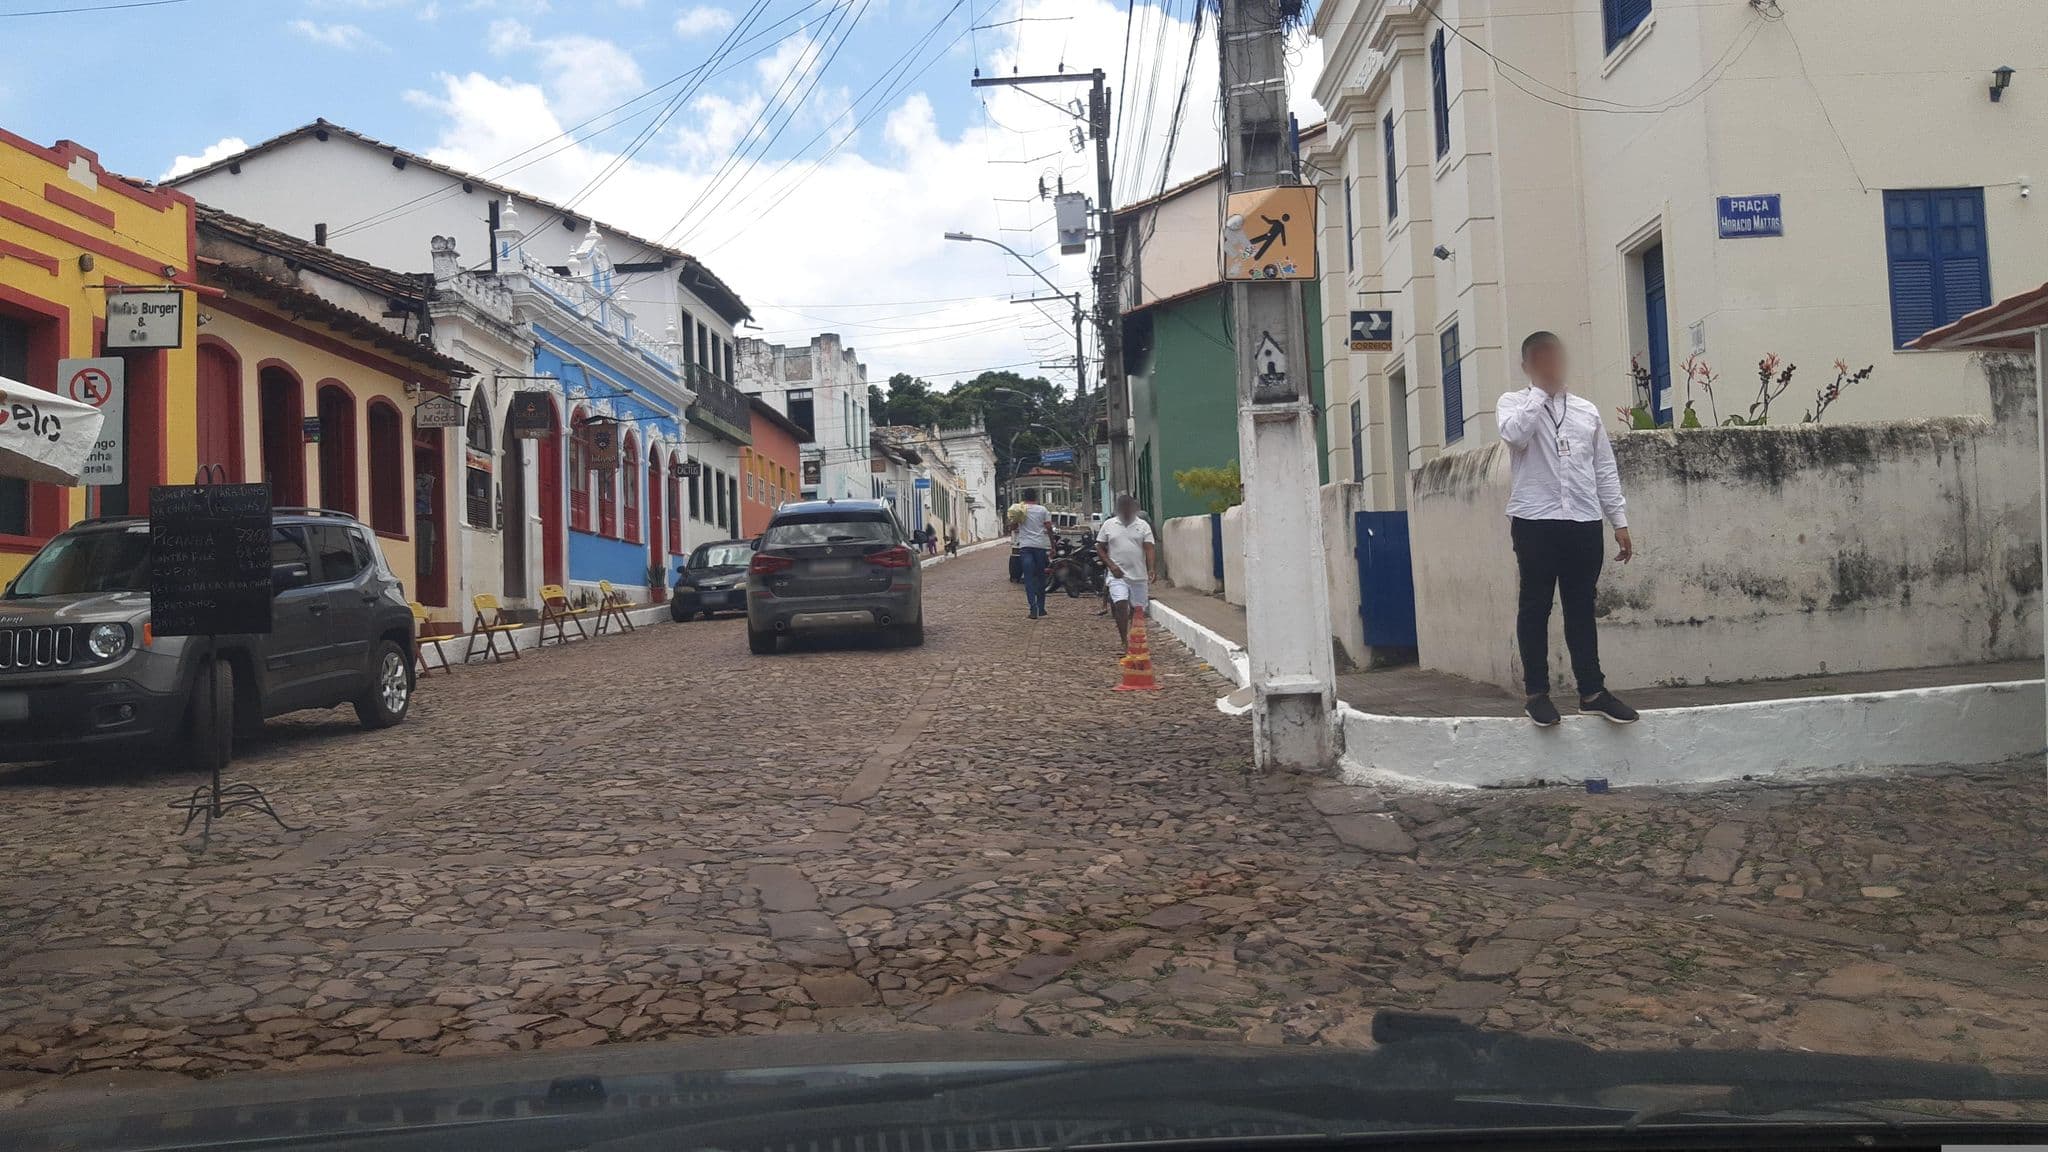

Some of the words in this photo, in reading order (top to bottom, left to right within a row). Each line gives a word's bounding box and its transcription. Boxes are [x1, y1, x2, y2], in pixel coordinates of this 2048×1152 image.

[1731, 200, 1769, 213] PRAÇA
[142, 302, 177, 317] Burger
[138, 317, 146, 327] &
[1350, 341, 1392, 351] CORREIOS
[94, 440, 116, 451] ngo
[83, 465, 114, 475] arela
